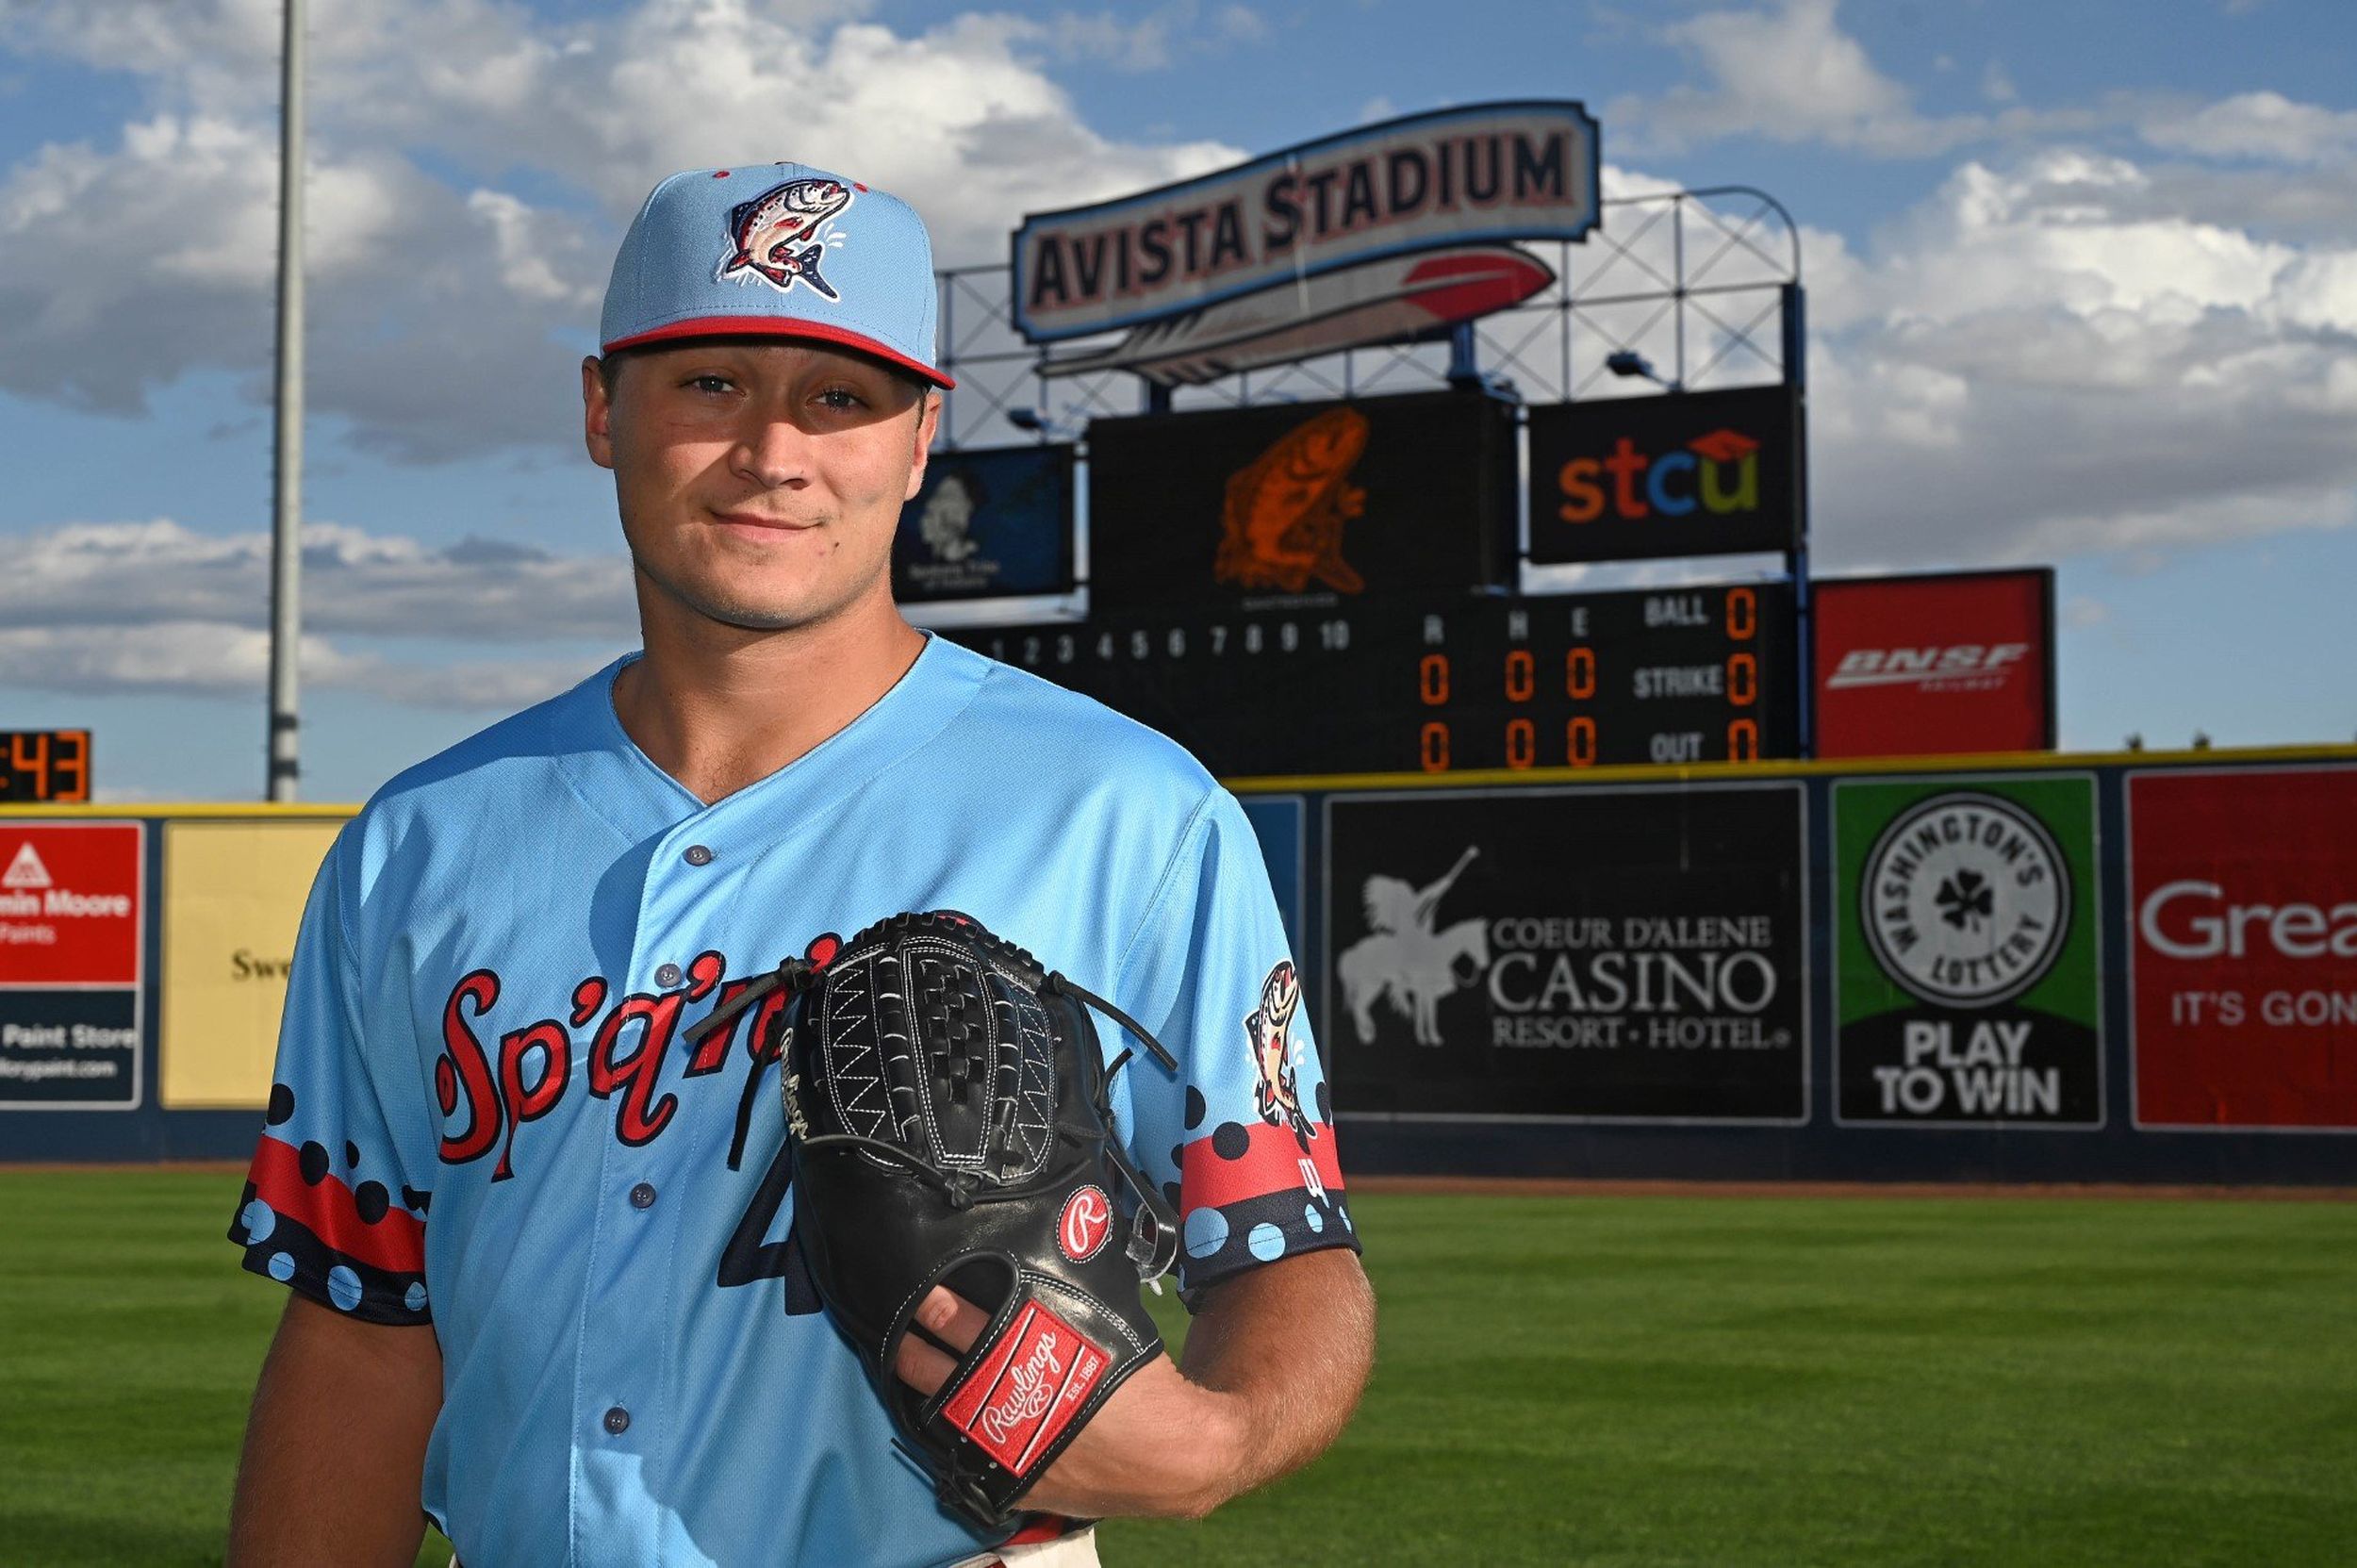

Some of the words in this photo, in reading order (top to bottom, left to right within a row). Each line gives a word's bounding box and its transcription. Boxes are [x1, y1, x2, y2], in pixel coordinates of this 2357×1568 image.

[1028, 196, 1250, 313] AVISTA
[1260, 130, 1575, 254] STADIUM
[1558, 437, 1760, 523] stcu
[1024, 635, 1040, 662] 2
[1058, 634, 1074, 663] 3
[1096, 632, 1113, 659] 4
[1132, 630, 1148, 660] 5
[1168, 627, 1185, 657] 6
[1211, 625, 1227, 654] 7
[1245, 623, 1262, 653] 8
[1281, 622, 1298, 652] 9
[1320, 619, 1349, 650] 10
[1424, 615, 1443, 644] R
[1509, 611, 1528, 640] H
[1572, 606, 1588, 636] E
[1644, 596, 1709, 627] BALL
[1726, 587, 1755, 640] 0
[1420, 652, 1449, 706] 0
[1505, 650, 1535, 702] 0
[1566, 647, 1595, 700] 0
[1634, 665, 1723, 699] STRIKE
[1727, 652, 1756, 705] 0
[1834, 643, 2029, 676] BNSF
[1421, 721, 1450, 774] 0
[1506, 718, 1535, 770] 0
[1567, 717, 1596, 768] 0
[1651, 733, 1704, 762] OUT
[45, 889, 131, 917] Moore
[1884, 814, 2044, 955] WASHINGTON'S
[1492, 917, 1609, 949] COEUR
[1931, 915, 2044, 985] LOTTERY
[1489, 951, 1776, 1014] CASINO
[2172, 990, 2245, 1027] IT'S
[3, 1023, 66, 1048] Paint
[72, 1023, 135, 1048] Store
[1492, 1017, 1626, 1048] RESORT
[1904, 1021, 2033, 1067] PLAY
[1873, 1067, 1944, 1114] TO
[1953, 1068, 2060, 1114] WIN
[982, 1331, 1060, 1444] Rawlings
[1065, 1381, 1086, 1401] Est.
[1080, 1356, 1100, 1381] 1887
